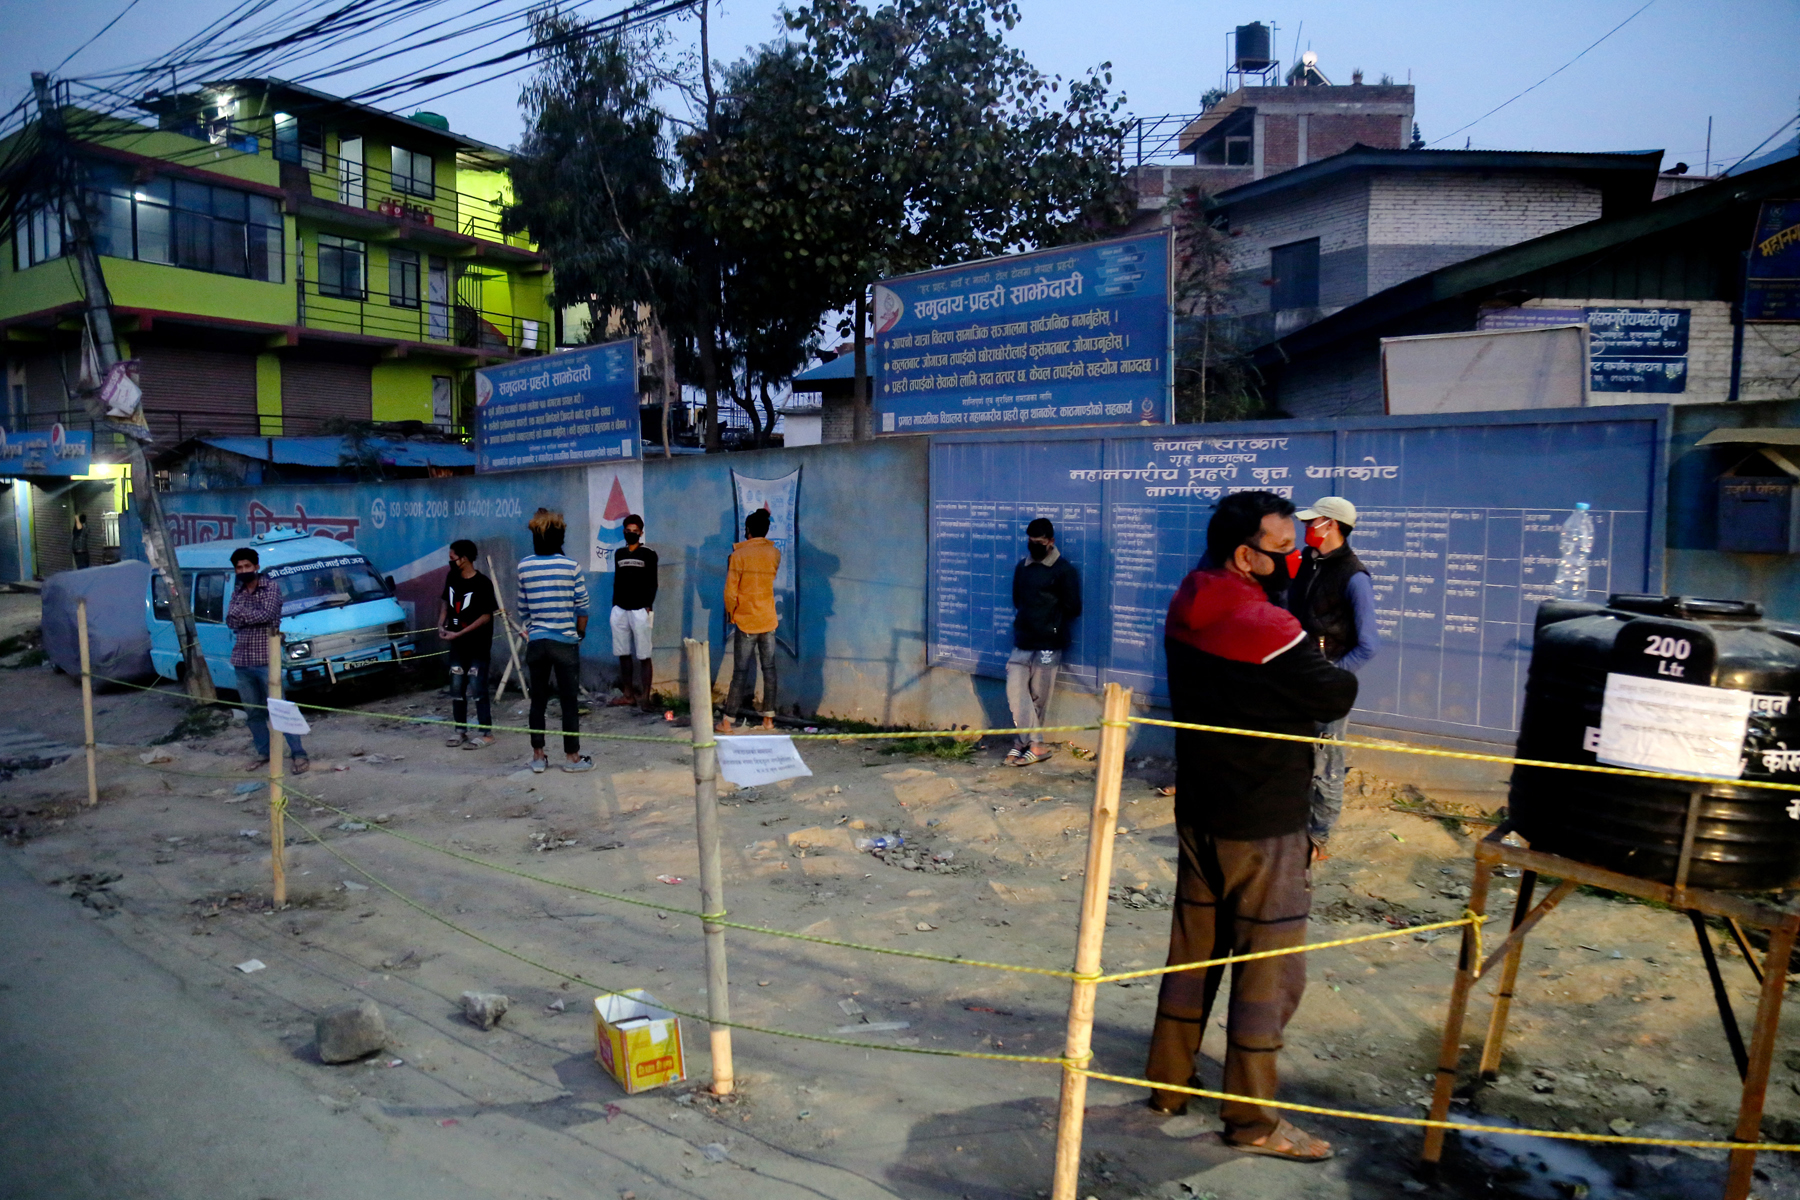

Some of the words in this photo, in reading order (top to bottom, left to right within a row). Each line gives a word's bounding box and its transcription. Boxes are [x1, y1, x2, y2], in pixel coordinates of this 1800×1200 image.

[1010, 271, 1084, 305] साझेदारी
[956, 324, 988, 342] सामाजिक
[552, 364, 591, 387] साझेदारी
[892, 377, 908, 394] प्रहरी
[980, 372, 994, 386] सदा
[1086, 358, 1118, 376] सहयोग
[1003, 406, 1018, 422] प्रहरी
[1152, 438, 1204, 452] नेपाल
[1069, 462, 1179, 482] महानगरीय
[1188, 463, 1238, 481] प्रहरी
[1305, 456, 1399, 482] थानकोट
[1170, 454, 1192, 468] गृह
[1198, 453, 1257, 465] मन्त्रालय
[1145, 480, 1222, 500] नागरिक
[390, 502, 400, 517] ISO
[426, 500, 448, 518] 2008
[454, 500, 466, 516] ISO
[495, 498, 522, 518] 2004
[1644, 635, 1691, 660] 200
